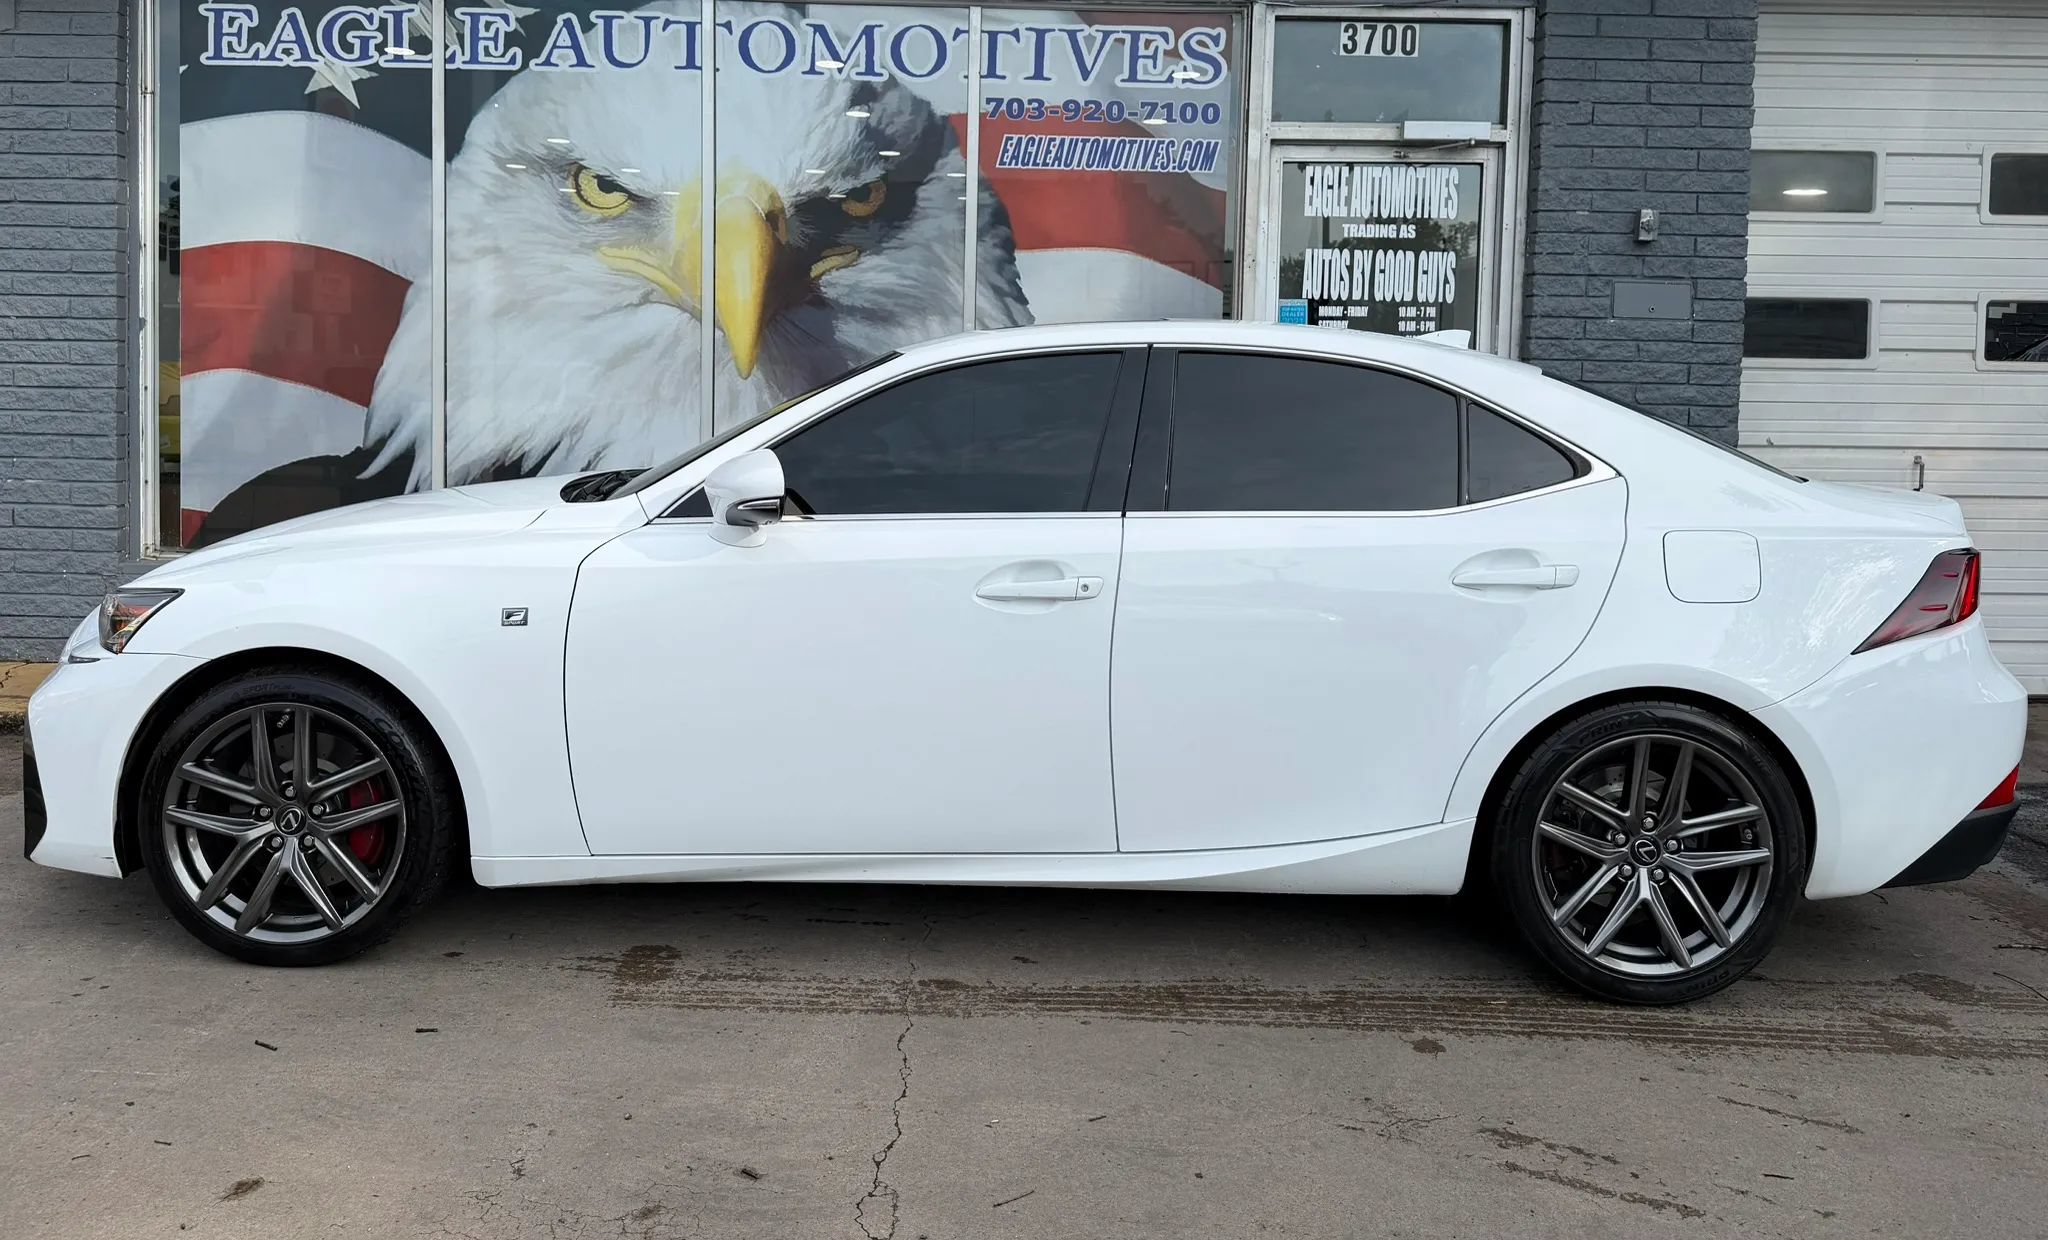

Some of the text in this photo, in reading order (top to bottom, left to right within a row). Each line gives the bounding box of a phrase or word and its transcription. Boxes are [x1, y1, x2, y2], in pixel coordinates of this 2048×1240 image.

[202, 6, 1225, 86] EAGLE AUTOMOTIVES
[1342, 23, 1417, 56] 3700
[985, 96, 1222, 125] 703-920-7100
[996, 134, 1219, 172] EAGLEAUTOMOTIVES.COM
[1304, 165, 1459, 219] EAGLE AUTOMOTIVES
[1342, 223, 1417, 239] TRADING AS
[1302, 248, 1457, 303] AUTOS BY GOOD GUYS
[1318, 306, 1344, 317] MONDAY
[1347, 306, 1369, 317] FRIDAY
[1398, 306, 1406, 318] 10
[1406, 306, 1417, 318] AM
[1426, 306, 1436, 318] PM
[1425, 320, 1436, 332] PM
